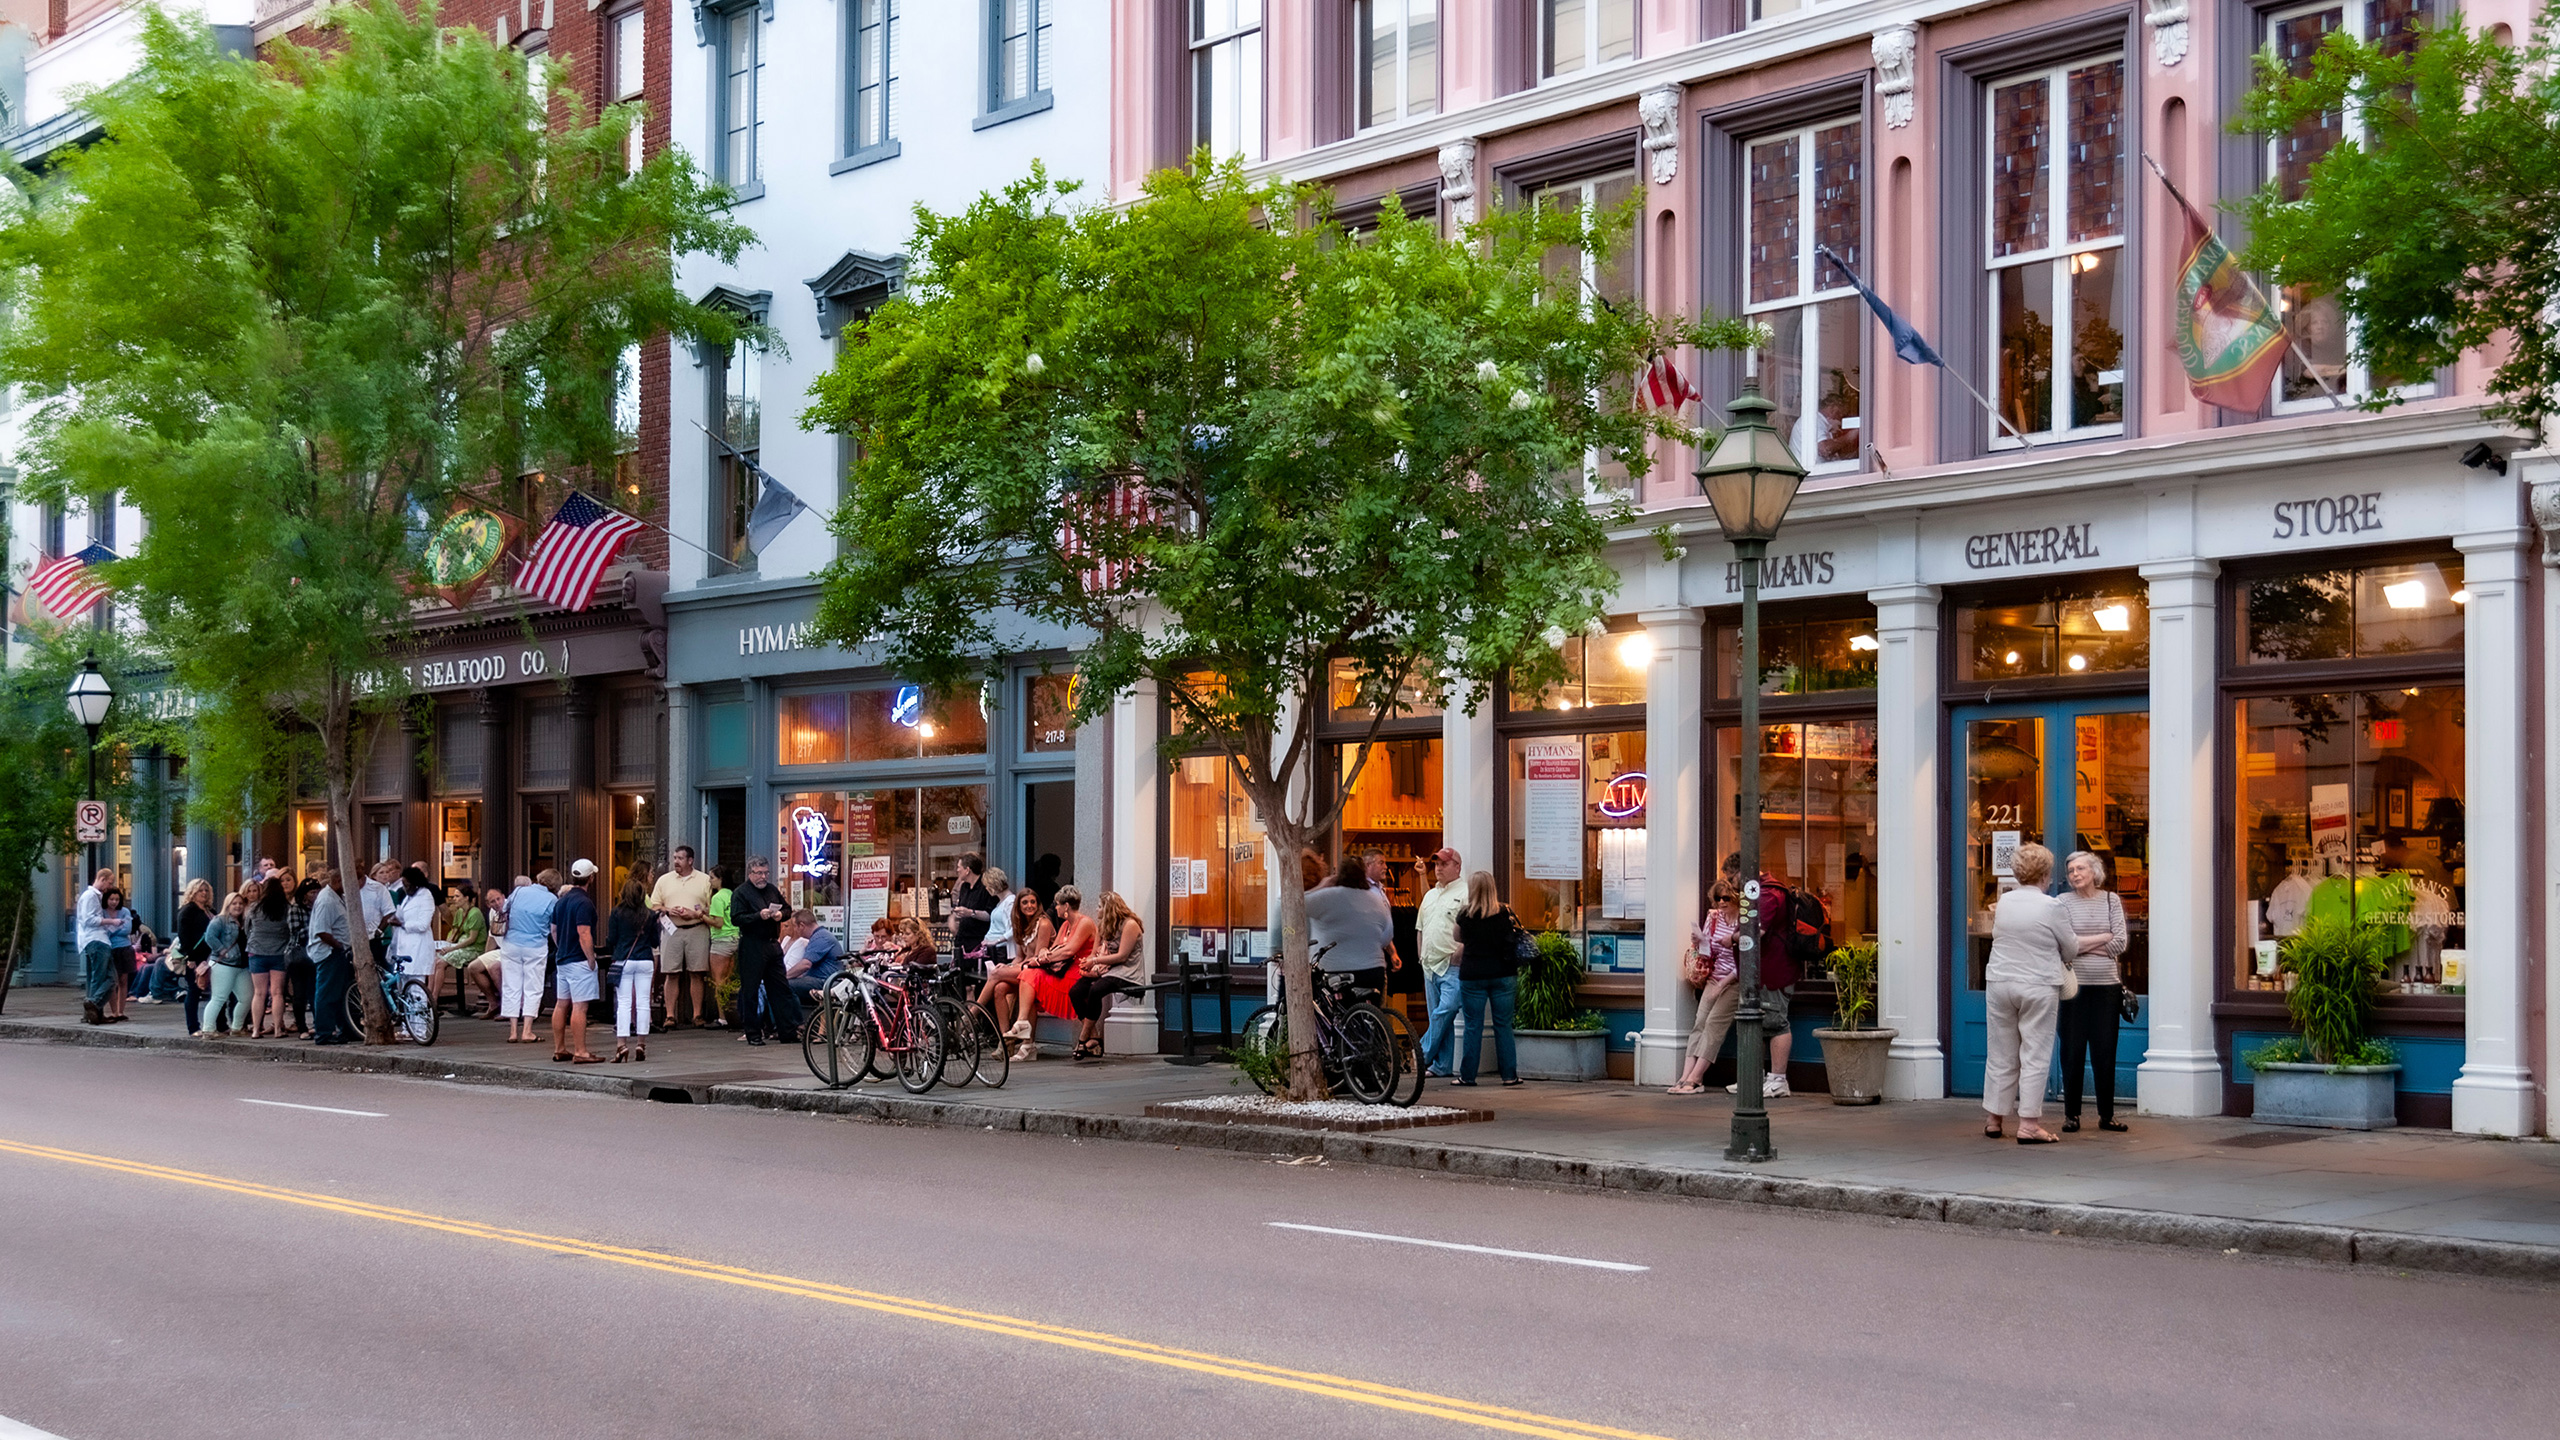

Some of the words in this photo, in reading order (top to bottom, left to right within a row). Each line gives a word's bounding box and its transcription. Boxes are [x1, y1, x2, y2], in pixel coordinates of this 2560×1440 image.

[2272, 491, 2383, 539] STORE
[1964, 522, 2100, 569] GENERAL
[1725, 551, 1835, 593] HMAN'S
[423, 655, 506, 687] SEAFOOD
[521, 650, 549, 675] CO.
[1045, 730, 1065, 743] 217-B
[2375, 721, 2398, 739] EXIT
[797, 744, 813, 757] 217
[1528, 745, 1573, 756] HYMAN'S
[1602, 784, 1648, 807] ATM
[1987, 804, 2023, 824] 221
[959, 820, 970, 829] SALE
[1235, 844, 1252, 860] OPEN
[854, 860, 884, 870] HYMAN'S
[2381, 878, 2450, 900] HYMAN'S
[2365, 912, 2424, 924] GENERAL
[2426, 911, 2465, 926] STORE
